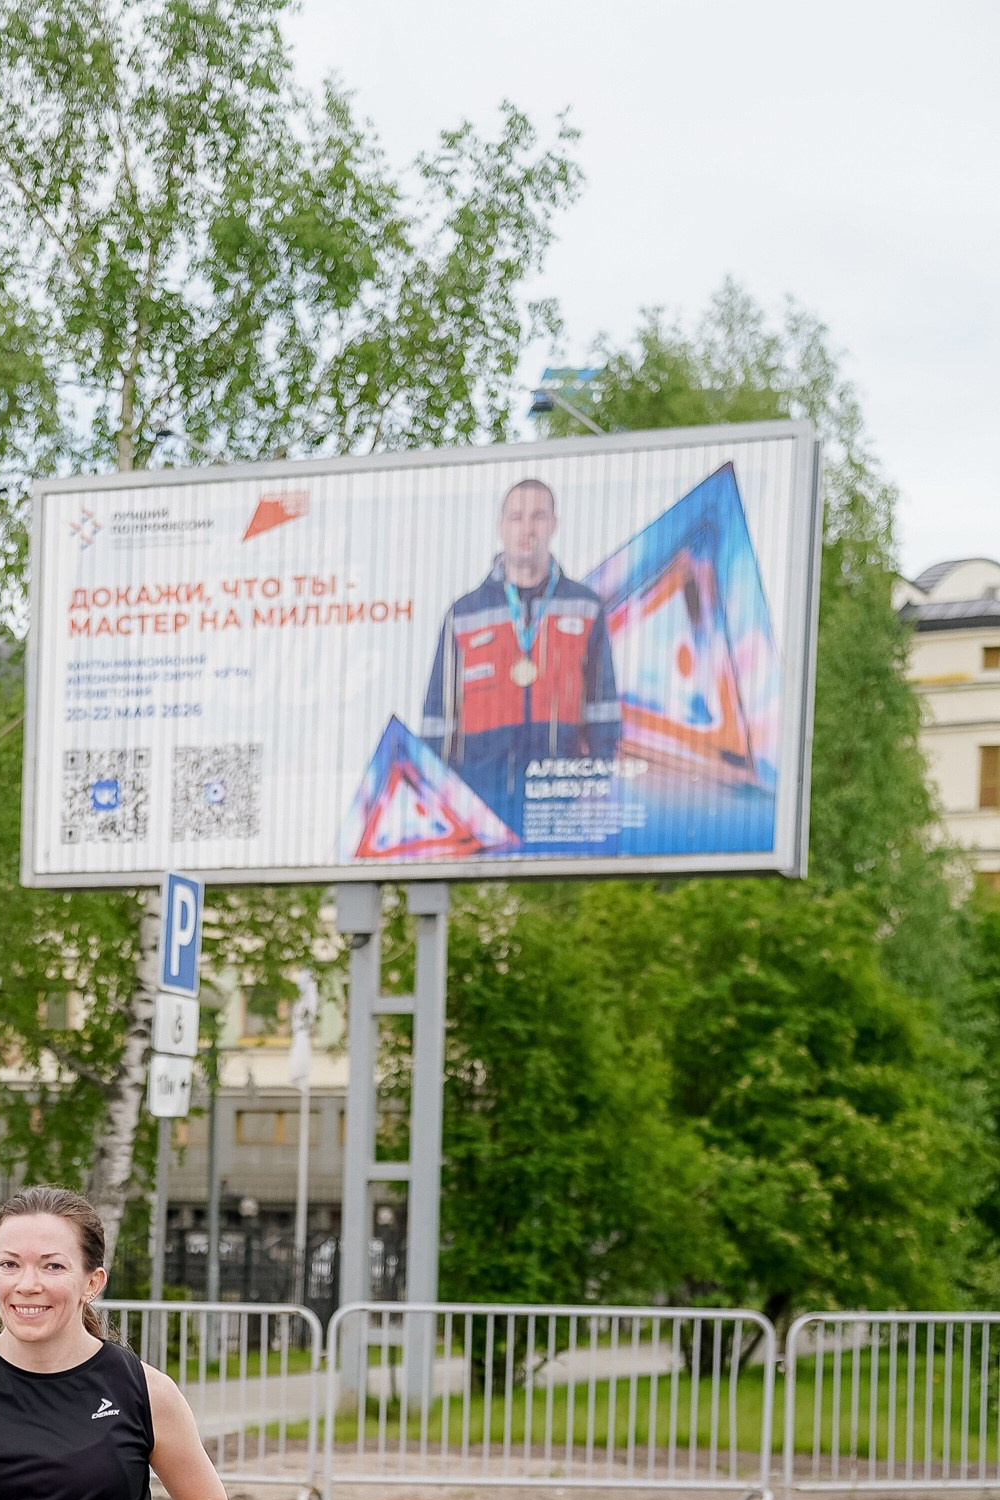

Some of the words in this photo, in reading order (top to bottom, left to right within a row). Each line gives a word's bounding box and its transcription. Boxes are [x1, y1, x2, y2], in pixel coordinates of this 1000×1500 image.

[68, 583, 212, 613] ДОКАЖИ,
[222, 576, 282, 598] ЧТО
[293, 575, 337, 595] ТЫ
[69, 613, 188, 638] МАСТЕР
[200, 608, 241, 631] НА
[252, 600, 414, 627] МИЛЛИОН
[170, 884, 196, 977] P
[91, 1409, 120, 1419] DEMIX
